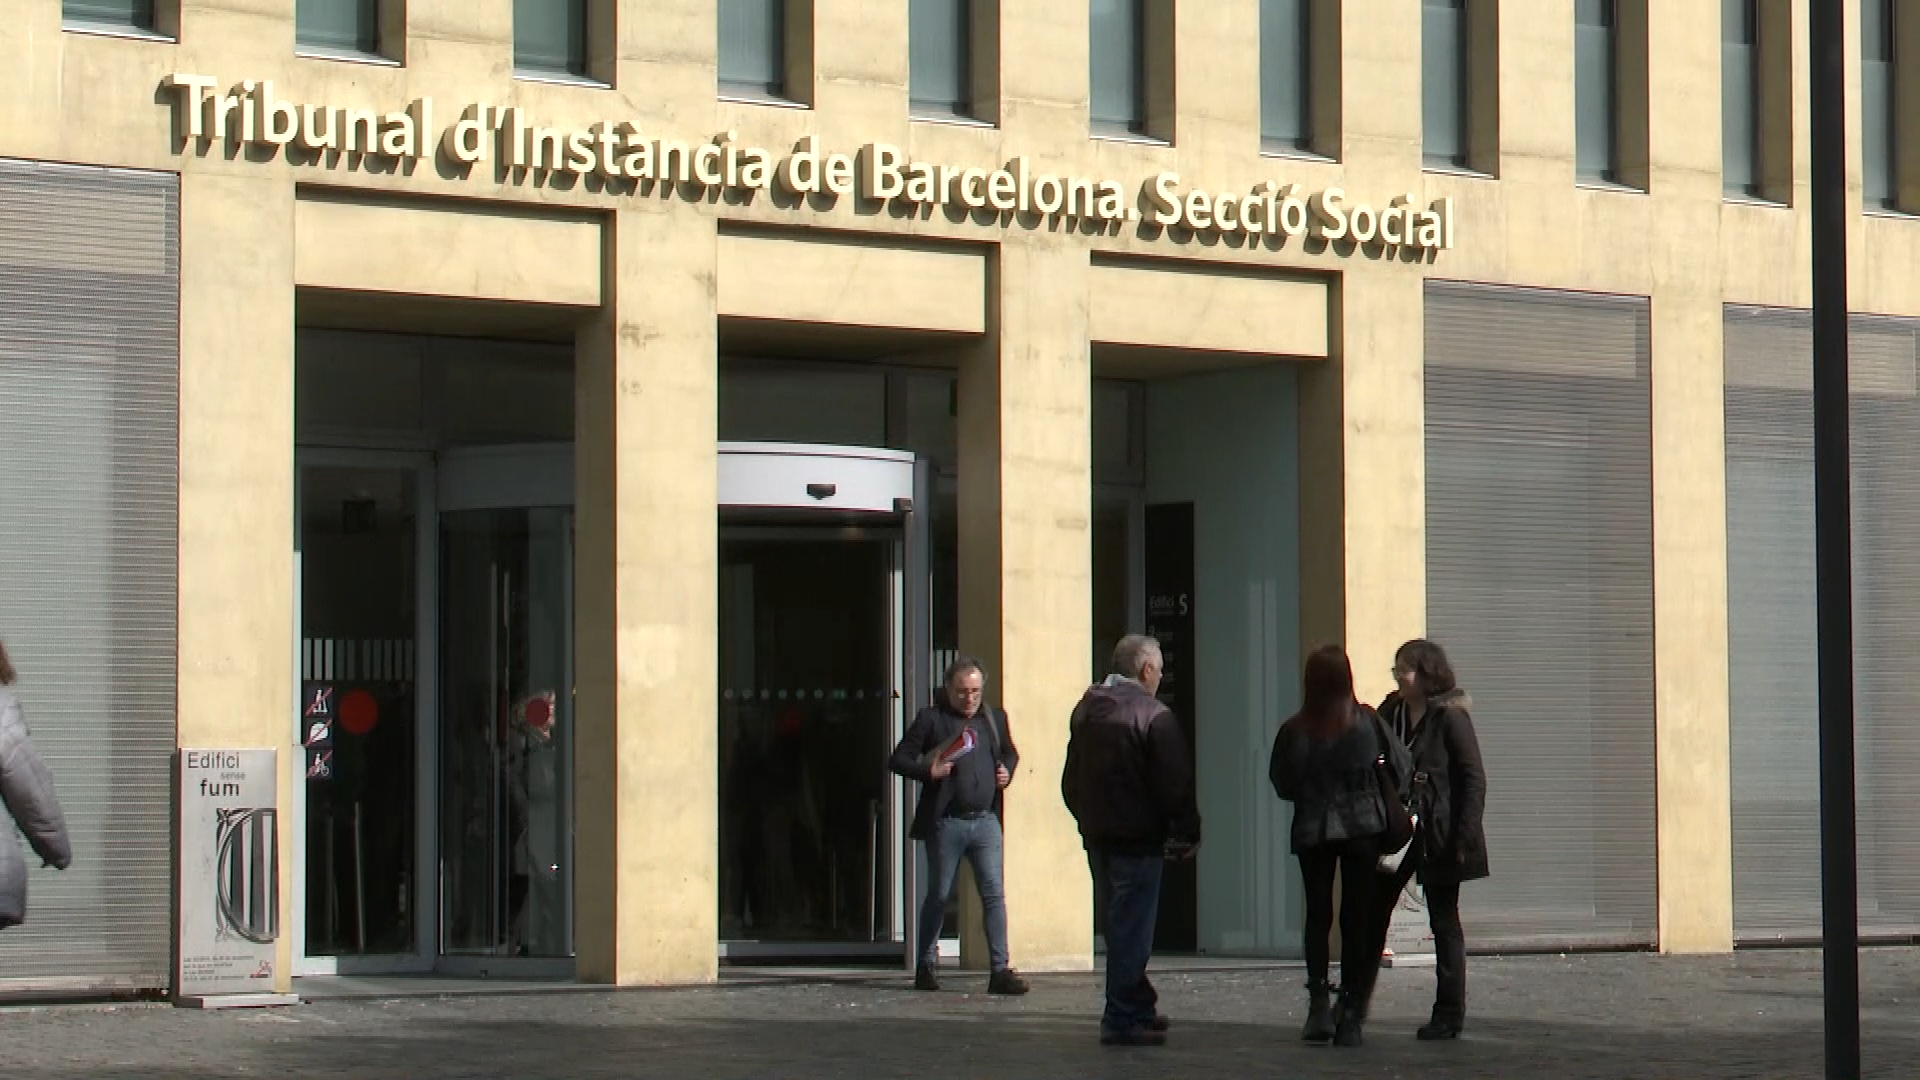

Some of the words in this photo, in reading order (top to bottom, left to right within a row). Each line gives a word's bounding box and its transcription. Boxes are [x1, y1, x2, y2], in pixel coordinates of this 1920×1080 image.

[173, 73, 432, 157] Tribunal
[453, 102, 772, 190] d'Instància
[788, 134, 855, 194] de
[872, 143, 1138, 221] Barcelona.
[1154, 169, 1306, 236] Secció
[1320, 186, 1454, 250] Social
[1179, 593, 1188, 616] S
[187, 751, 240, 769] Edifici
[220, 771, 246, 781] sense
[200, 778, 240, 797] fum
